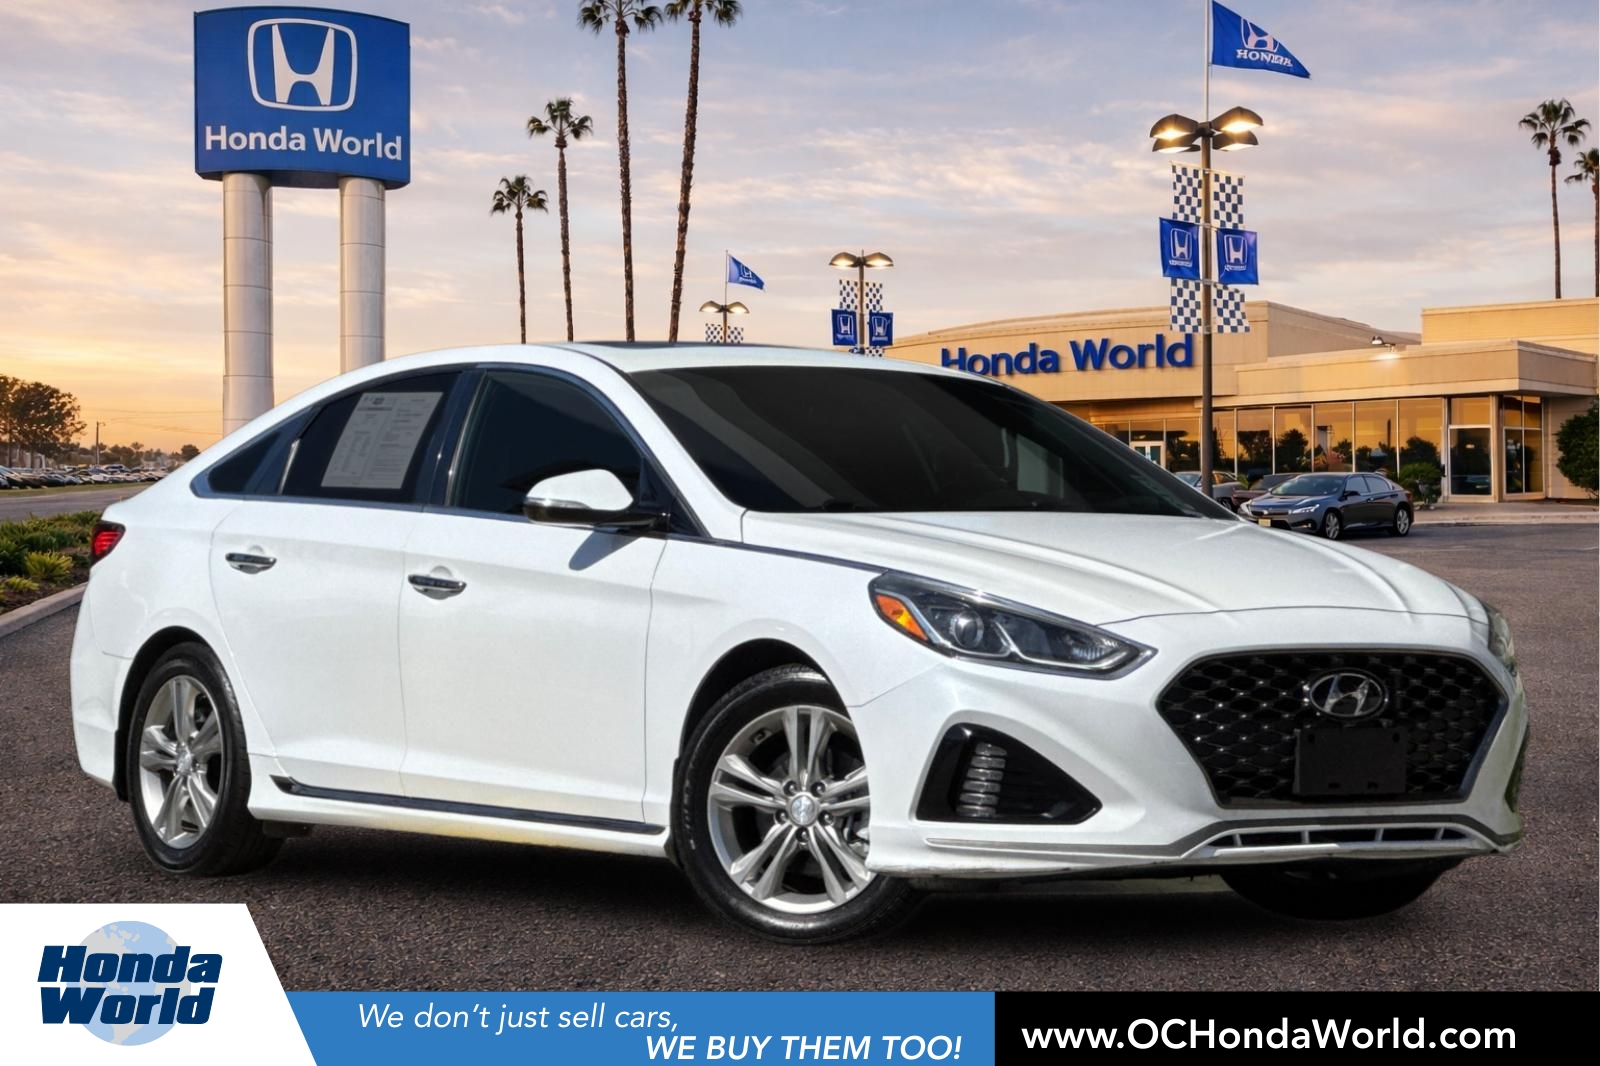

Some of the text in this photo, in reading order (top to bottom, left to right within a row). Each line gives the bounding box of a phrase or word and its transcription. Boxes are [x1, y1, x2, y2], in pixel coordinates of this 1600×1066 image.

[205, 125, 402, 161] Honda World
[941, 333, 1193, 377] Honda World
